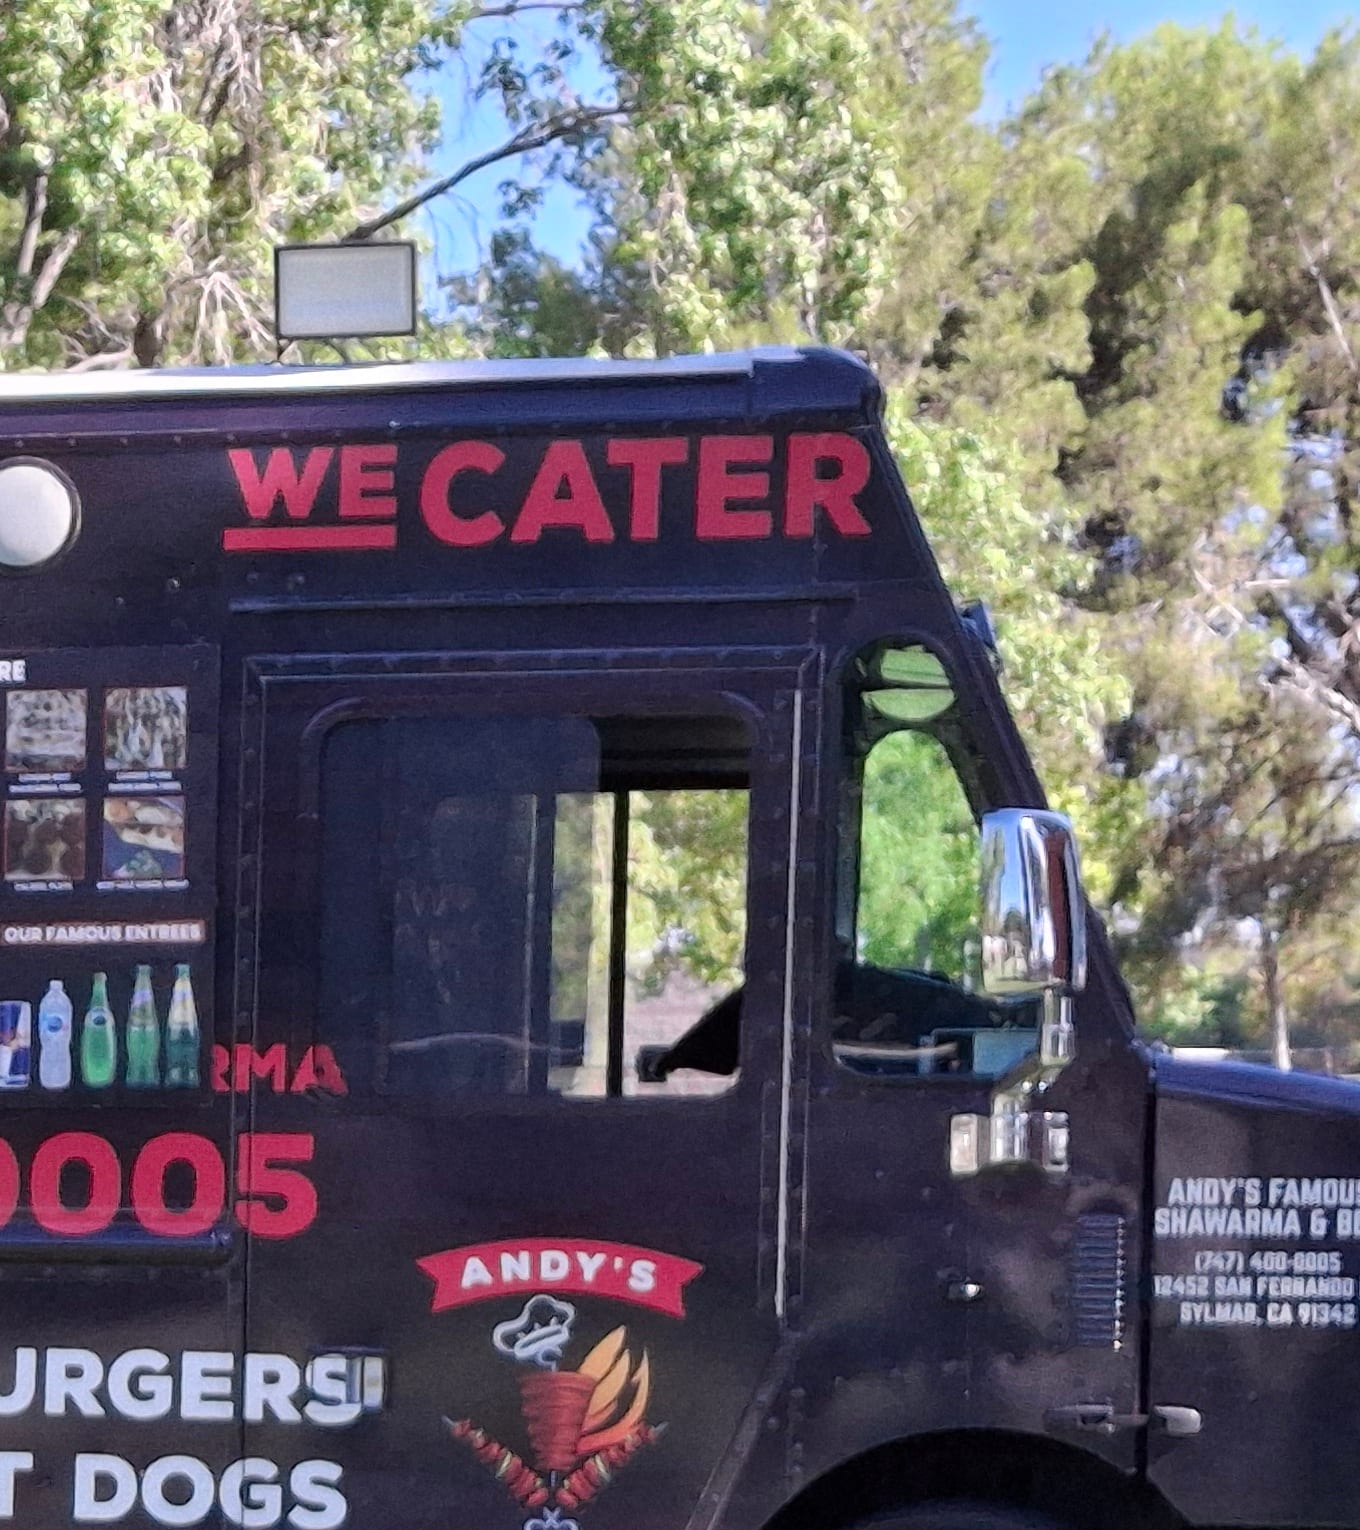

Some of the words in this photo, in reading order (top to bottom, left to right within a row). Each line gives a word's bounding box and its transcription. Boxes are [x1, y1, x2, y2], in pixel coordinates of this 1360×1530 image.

[228, 445, 398, 520] WE
[419, 432, 871, 547] CATER
[1167, 1177, 1262, 1207] ANDY'S
[1154, 1207, 1302, 1238] SHAWARMA
[461, 1250, 657, 1292] ANDY'S
[1214, 1275, 1253, 1298] SAN
[1267, 1302, 1293, 1326] CA
[73, 1454, 347, 1530] DOGS
